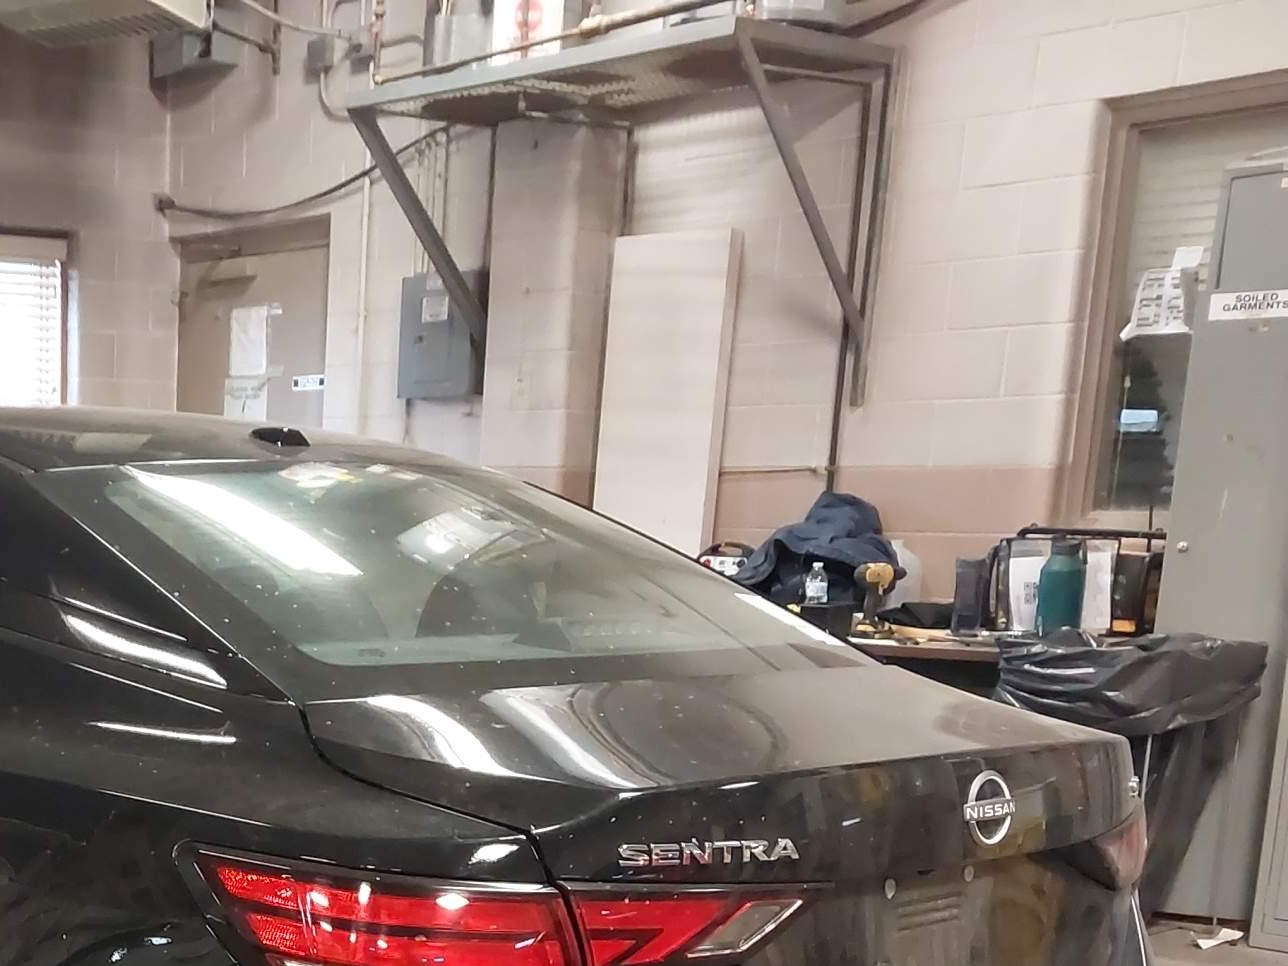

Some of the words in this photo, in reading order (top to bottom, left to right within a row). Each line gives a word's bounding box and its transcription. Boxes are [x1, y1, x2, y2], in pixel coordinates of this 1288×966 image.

[1235, 293, 1279, 303] SOILED
[1222, 301, 1288, 312] GARMENTS
[966, 802, 1015, 819] NISSAN
[617, 838, 800, 867] SENTRA
